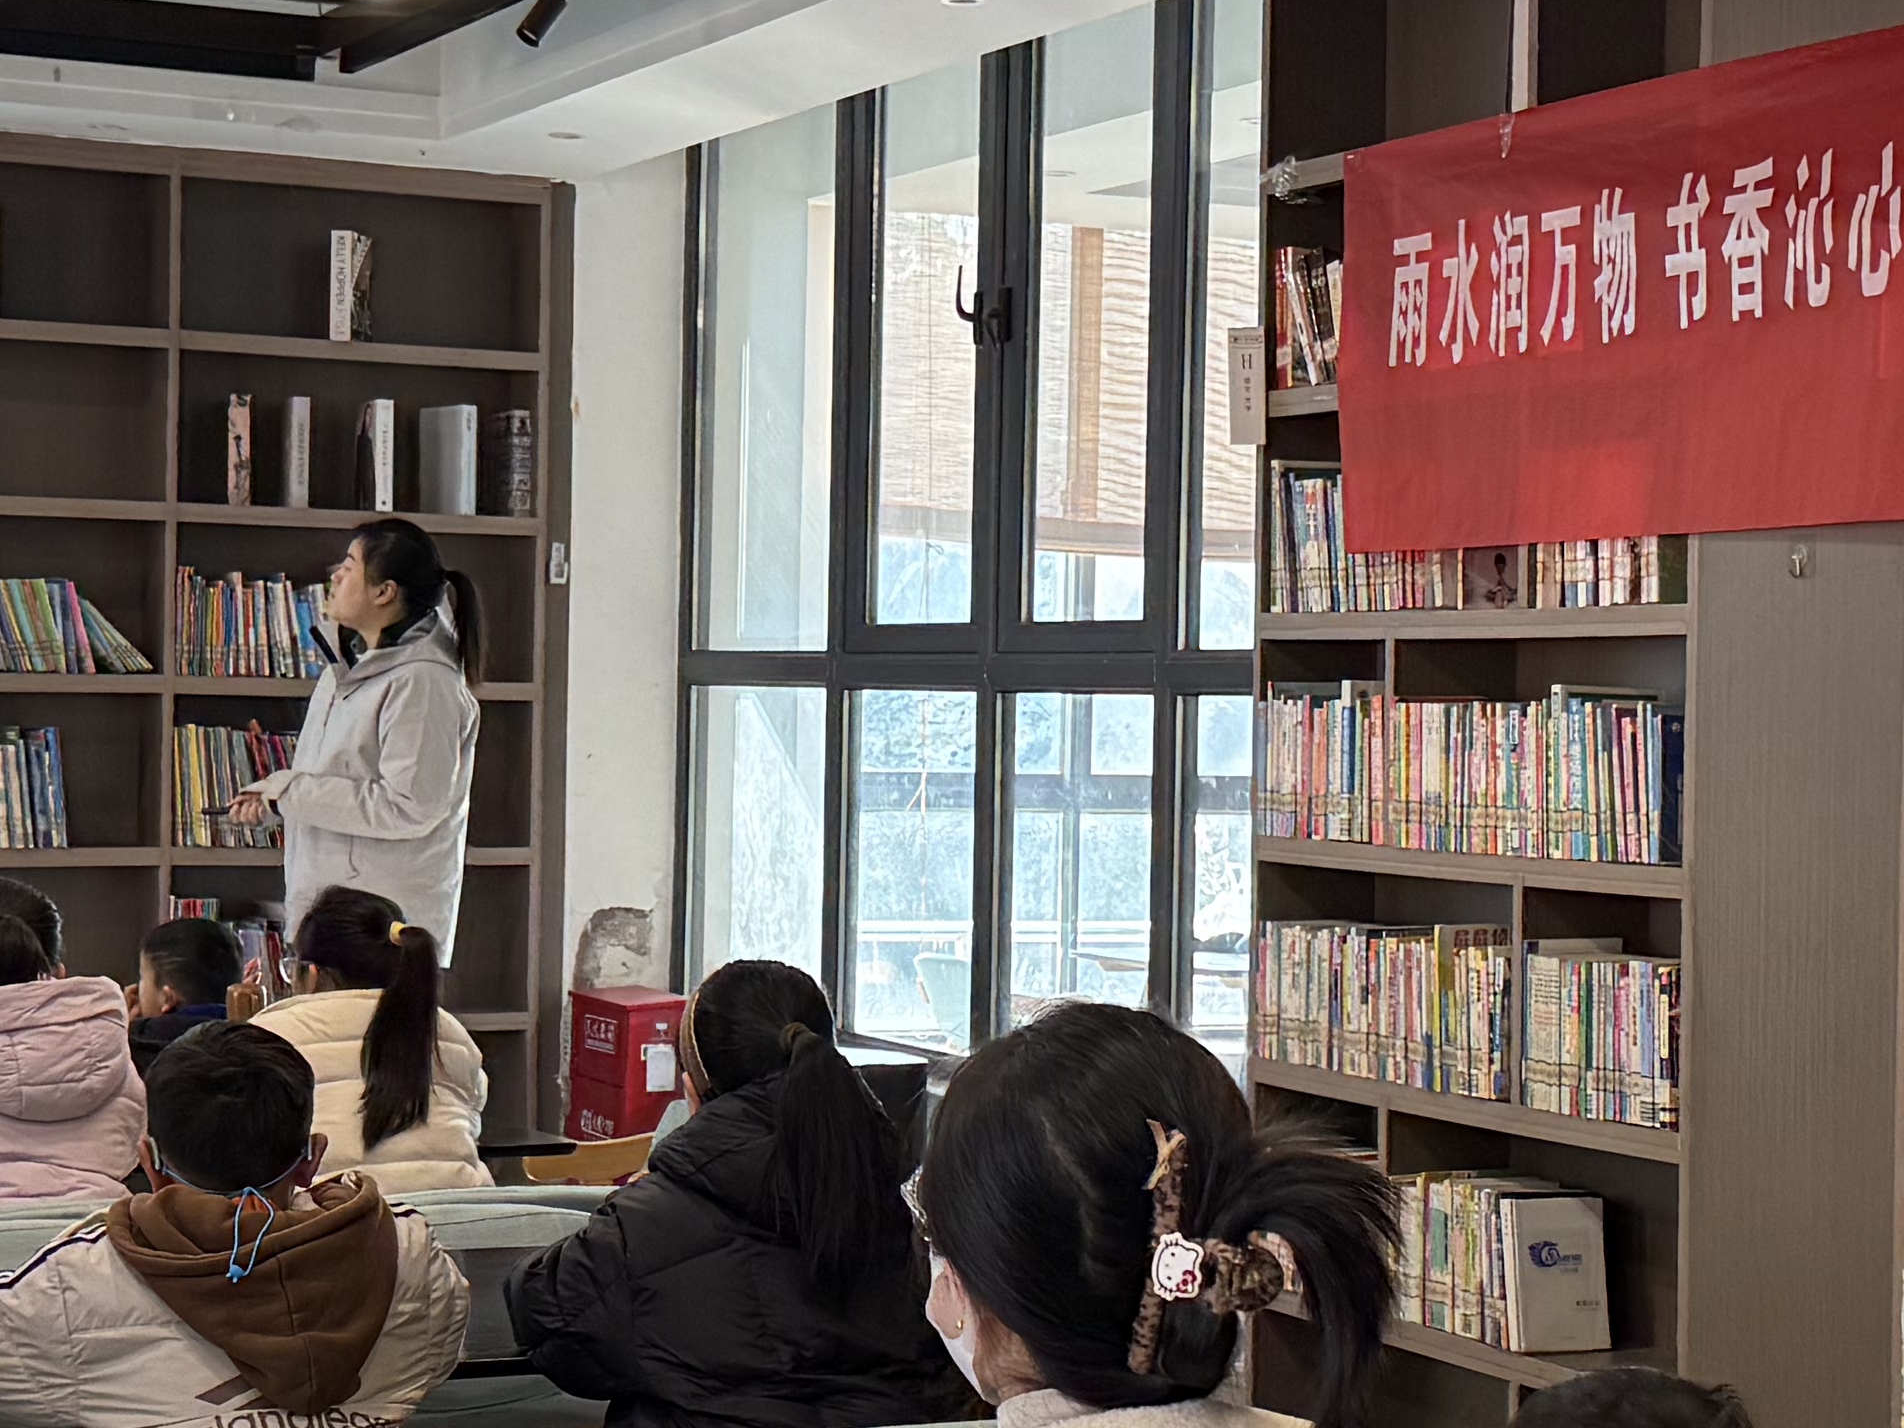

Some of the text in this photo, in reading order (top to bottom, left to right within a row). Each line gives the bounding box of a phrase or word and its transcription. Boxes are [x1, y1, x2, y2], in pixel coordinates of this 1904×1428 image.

[1388, 186, 1637, 367] 雨水润万物
